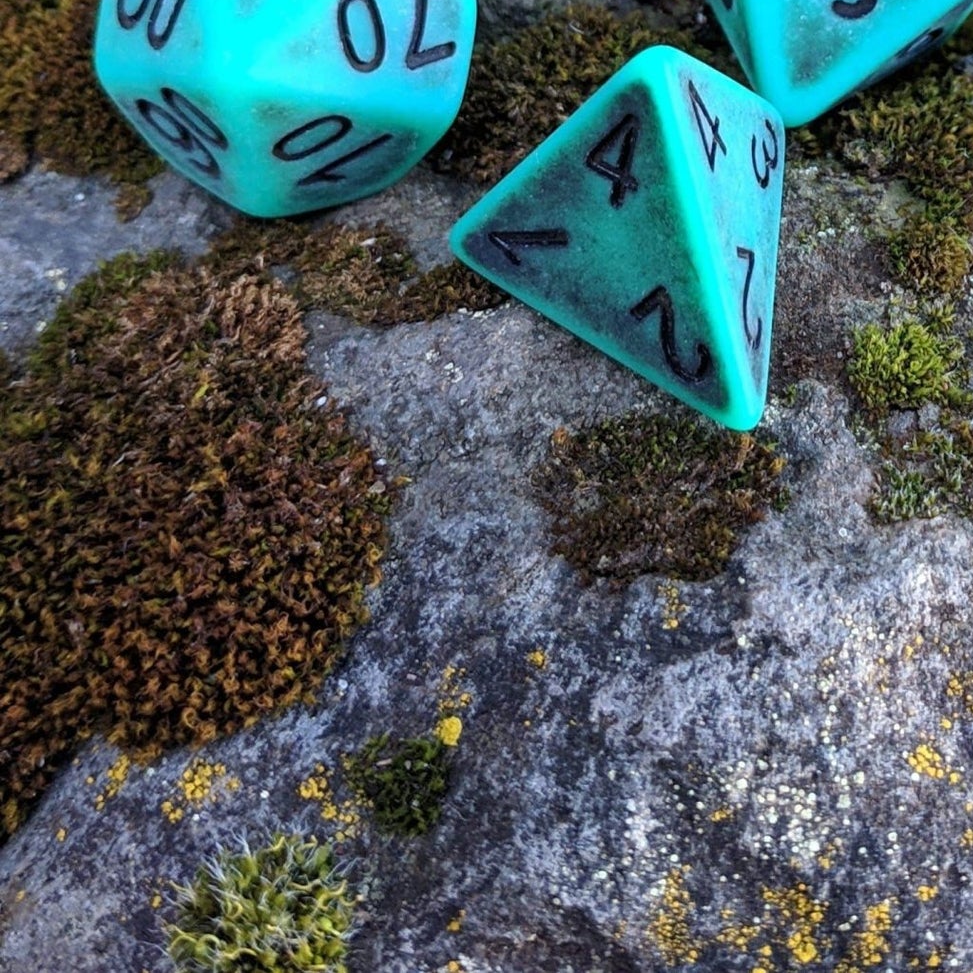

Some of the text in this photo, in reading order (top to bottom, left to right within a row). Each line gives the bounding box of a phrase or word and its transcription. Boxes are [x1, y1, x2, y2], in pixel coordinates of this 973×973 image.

[272, 115, 394, 187] 10
[584, 114, 638, 209] 4
[688, 79, 727, 172] 4
[751, 118, 778, 190] 3
[487, 228, 569, 266] 1
[629, 284, 711, 382] 2
[736, 246, 762, 350] 2
